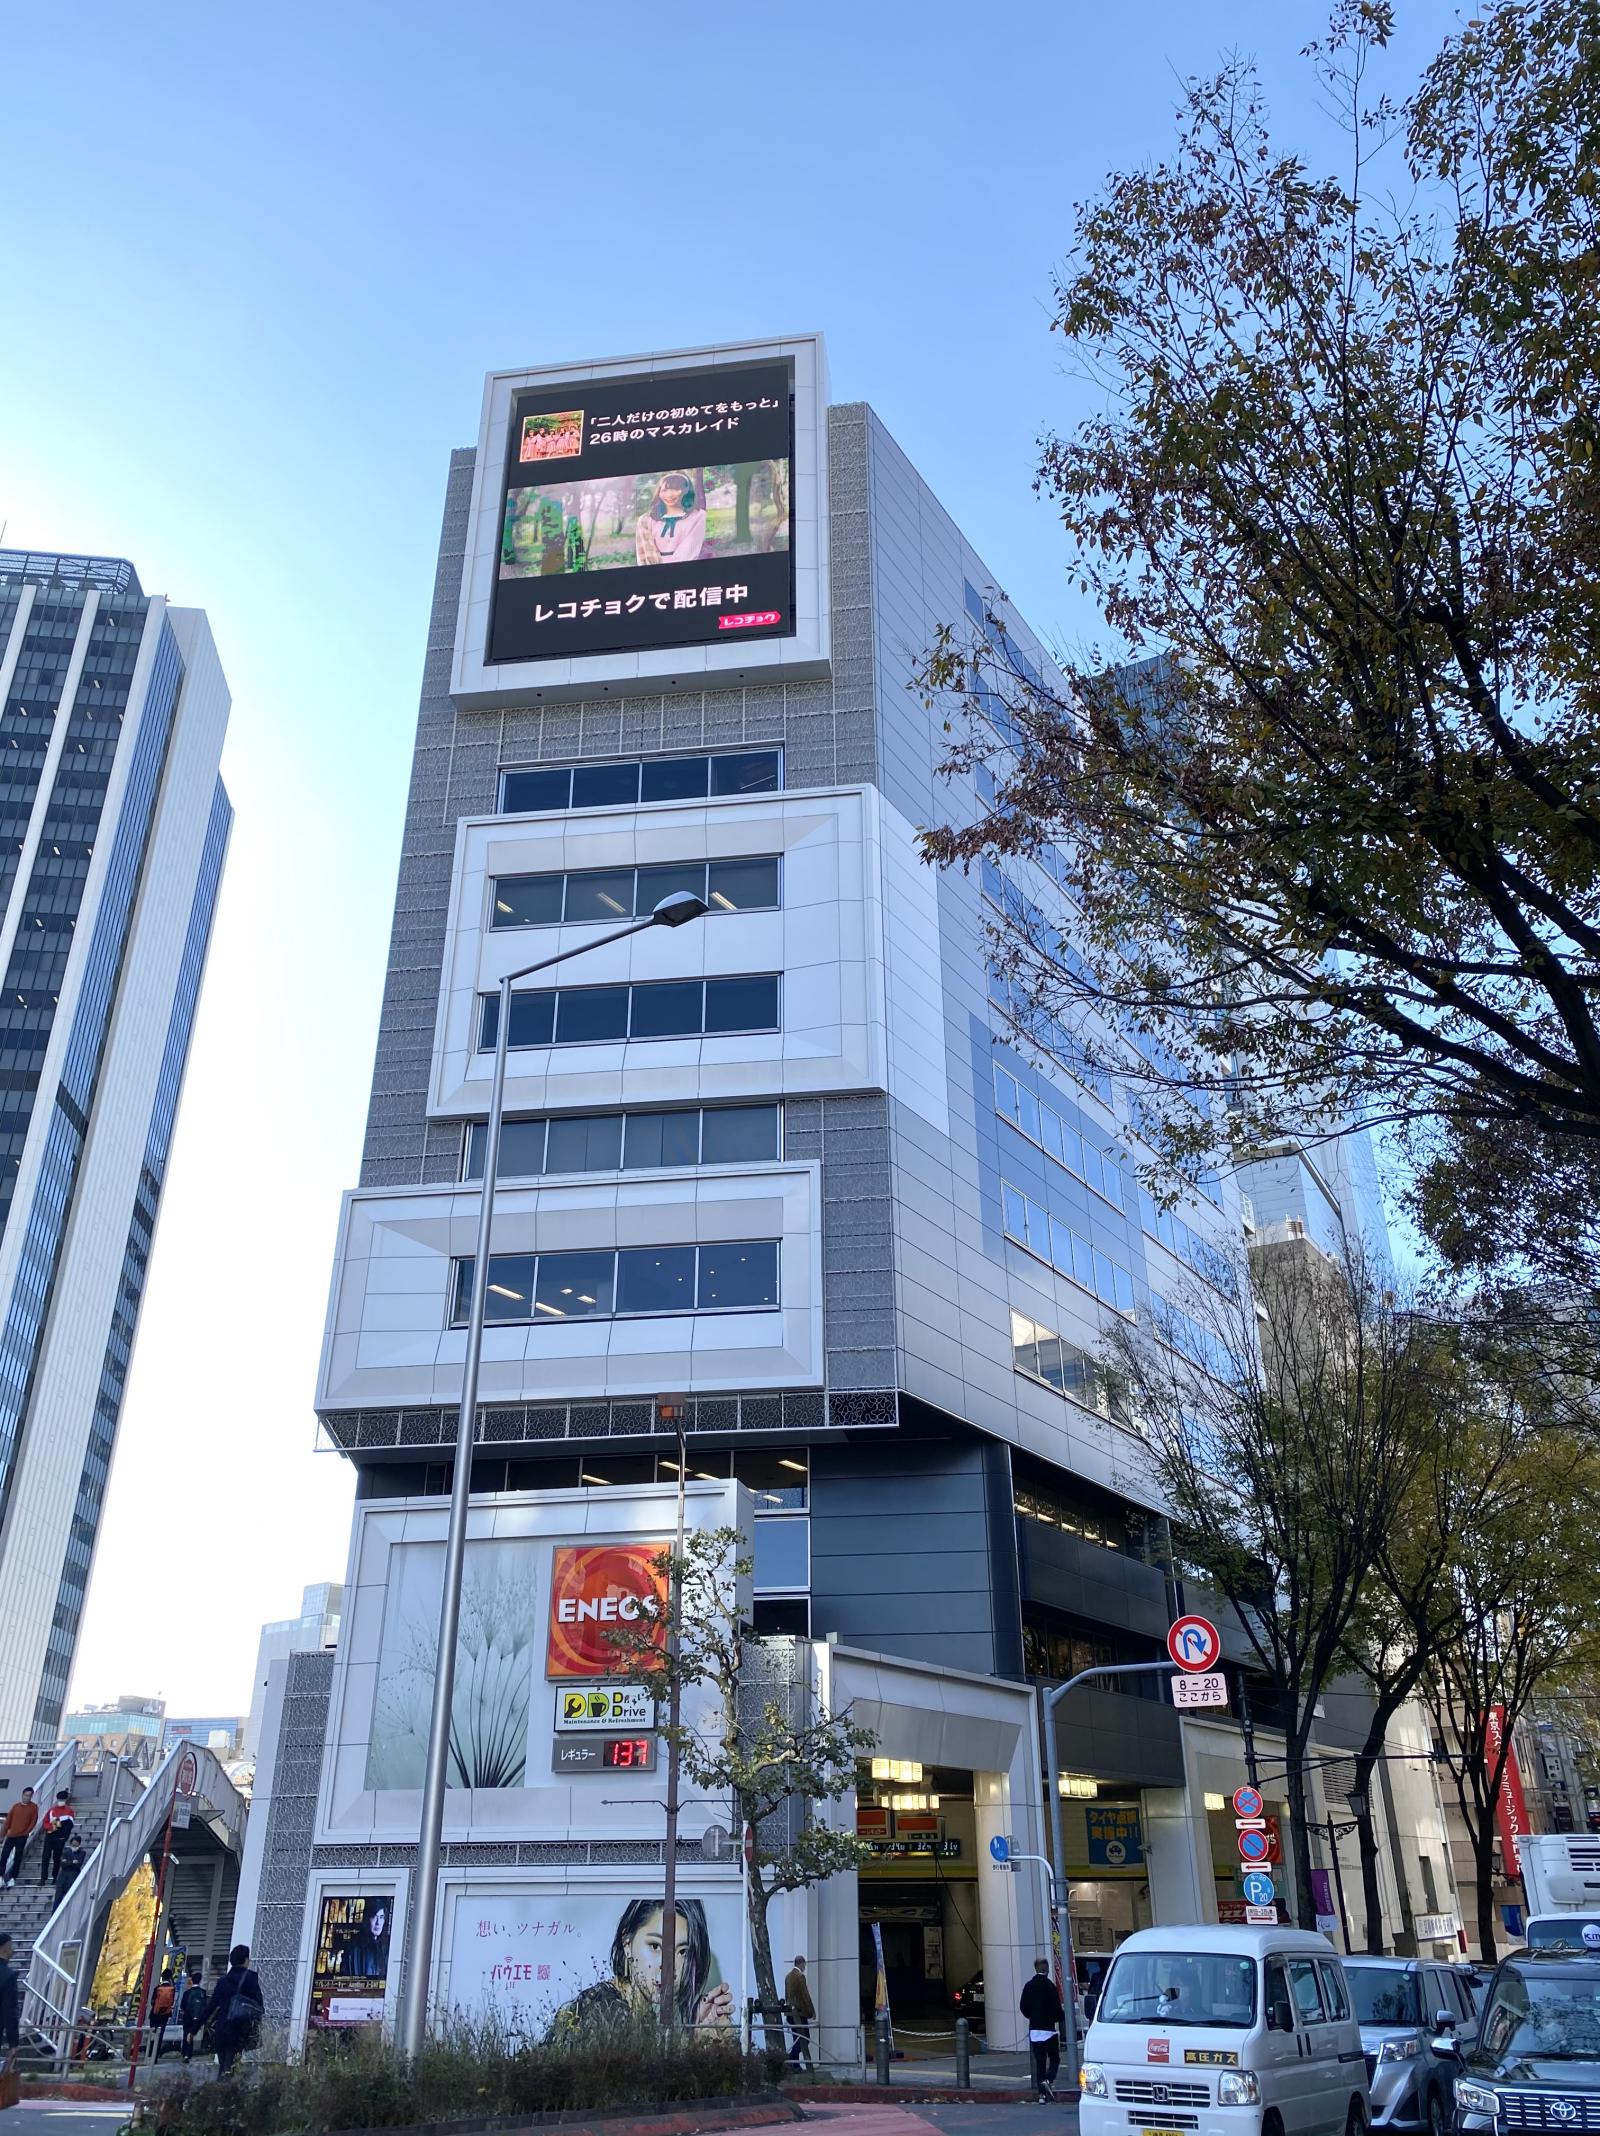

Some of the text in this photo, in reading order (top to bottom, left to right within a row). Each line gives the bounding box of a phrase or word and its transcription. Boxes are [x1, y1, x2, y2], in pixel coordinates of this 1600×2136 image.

[589, 417, 740, 445] 26時のマスカレイド
[535, 584, 748, 622] レコチョクで配信中
[724, 613, 775, 626] レコチョク
[1179, 1692, 1221, 1702] ここから
[612, 1705, 646, 1717] Drive
[561, 1748, 596, 1760] レギュラー
[613, 1740, 648, 1766] 137
[476, 1920, 582, 1938] 想い、ツナガル。
[1185, 2052, 1237, 2064] 高圧ガス
